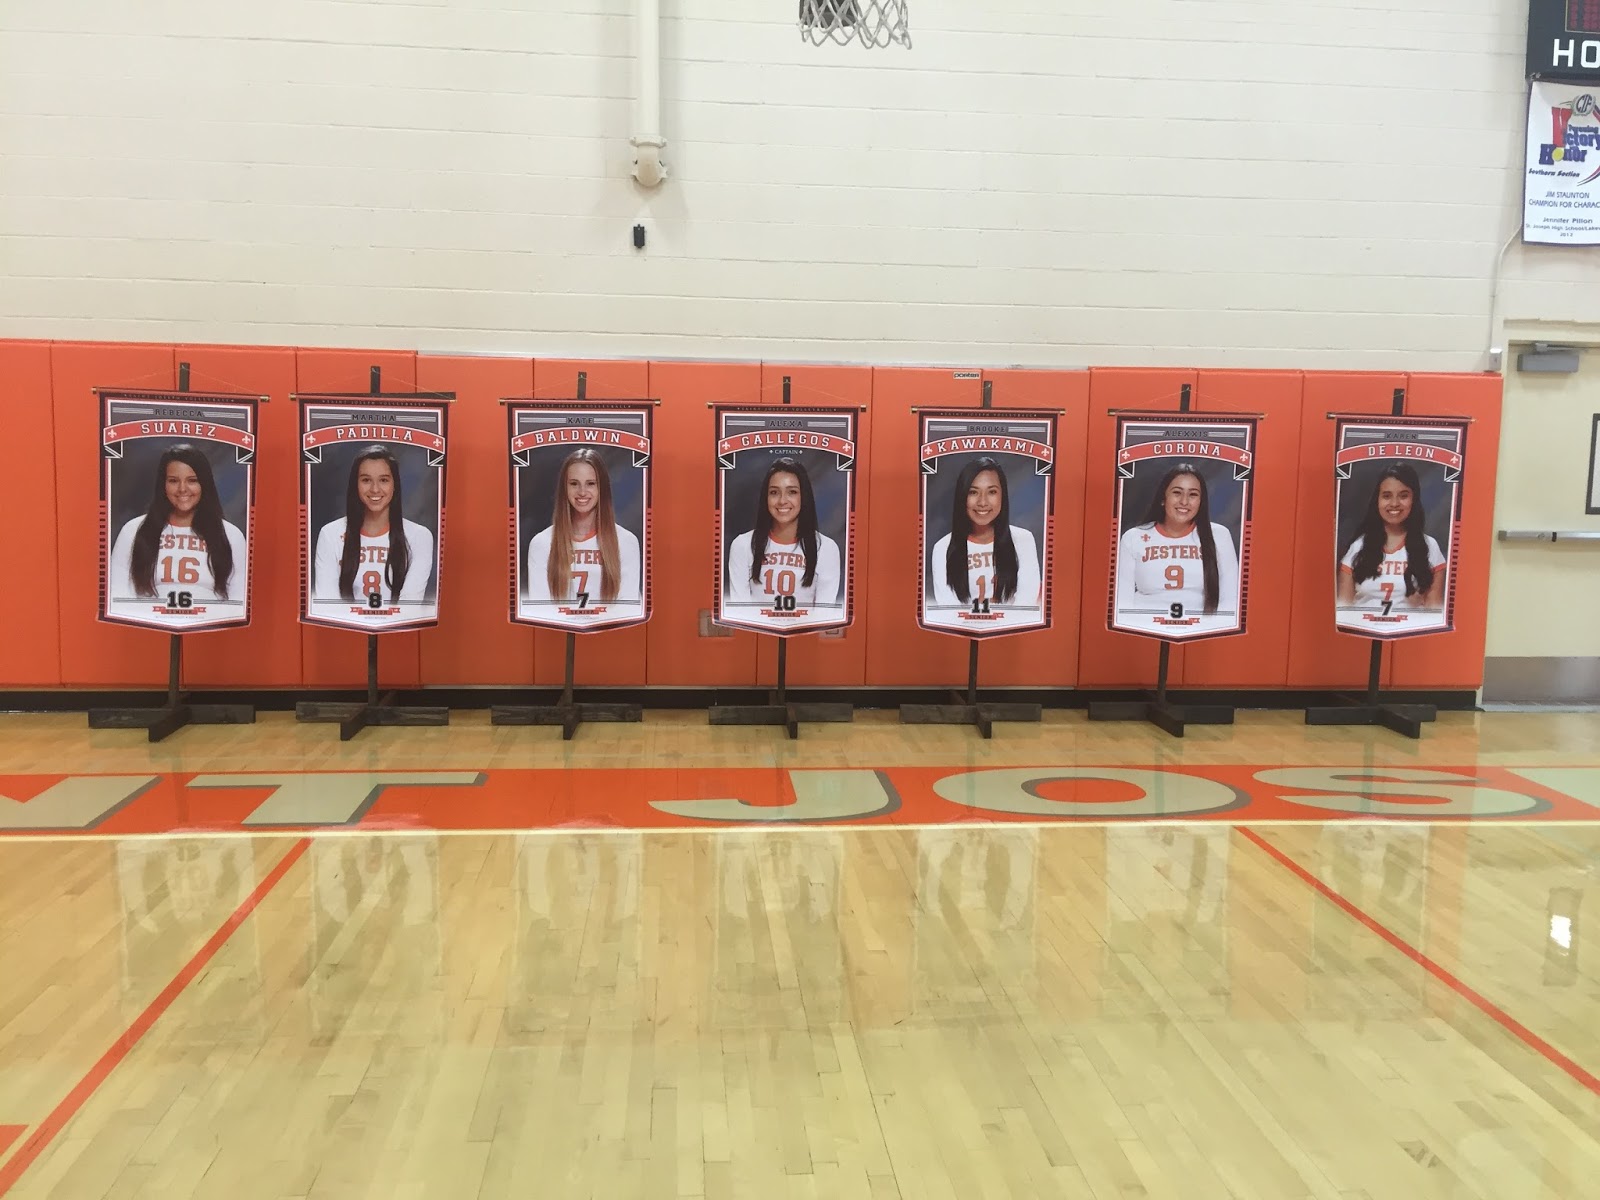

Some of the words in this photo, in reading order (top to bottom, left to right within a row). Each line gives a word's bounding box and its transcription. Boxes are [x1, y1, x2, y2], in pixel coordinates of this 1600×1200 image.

[1552, 38, 1600, 68] HO
[1576, 94, 1593, 113] CIF
[1528, 168, 1556, 176] Southern
[1528, 198, 1558, 207] CHAMPION
[1556, 191, 1590, 199] STAUNTON
[155, 408, 202, 417] REBECCA
[352, 414, 395, 422] MARTHA
[141, 422, 218, 437] SUAREZ
[336, 427, 413, 441] PADILLA
[535, 430, 621, 444] BALDWIN
[969, 425, 1005, 433] BROOKE
[741, 433, 830, 447] GALLEGOS
[936, 438, 1035, 453] KAWAKAMI
[1153, 443, 1220, 456] CORONA
[1368, 445, 1386, 456] DE
[1394, 445, 1435, 459] LEON
[159, 534, 208, 552] ESTER
[762, 552, 807, 568] ESTER
[160, 555, 201, 584] 16
[1164, 565, 1184, 590] 9
[362, 570, 382, 598] 8
[571, 570, 589, 595] 7
[763, 568, 796, 596] 10
[167, 591, 193, 608] 16
[1380, 582, 1395, 601] 7
[368, 592, 382, 609] 8
[576, 592, 590, 609] 7
[774, 595, 797, 611] 10
[972, 598, 990, 614] 11
[1381, 601, 1393, 616] 7
[1170, 602, 1183, 619] 9
